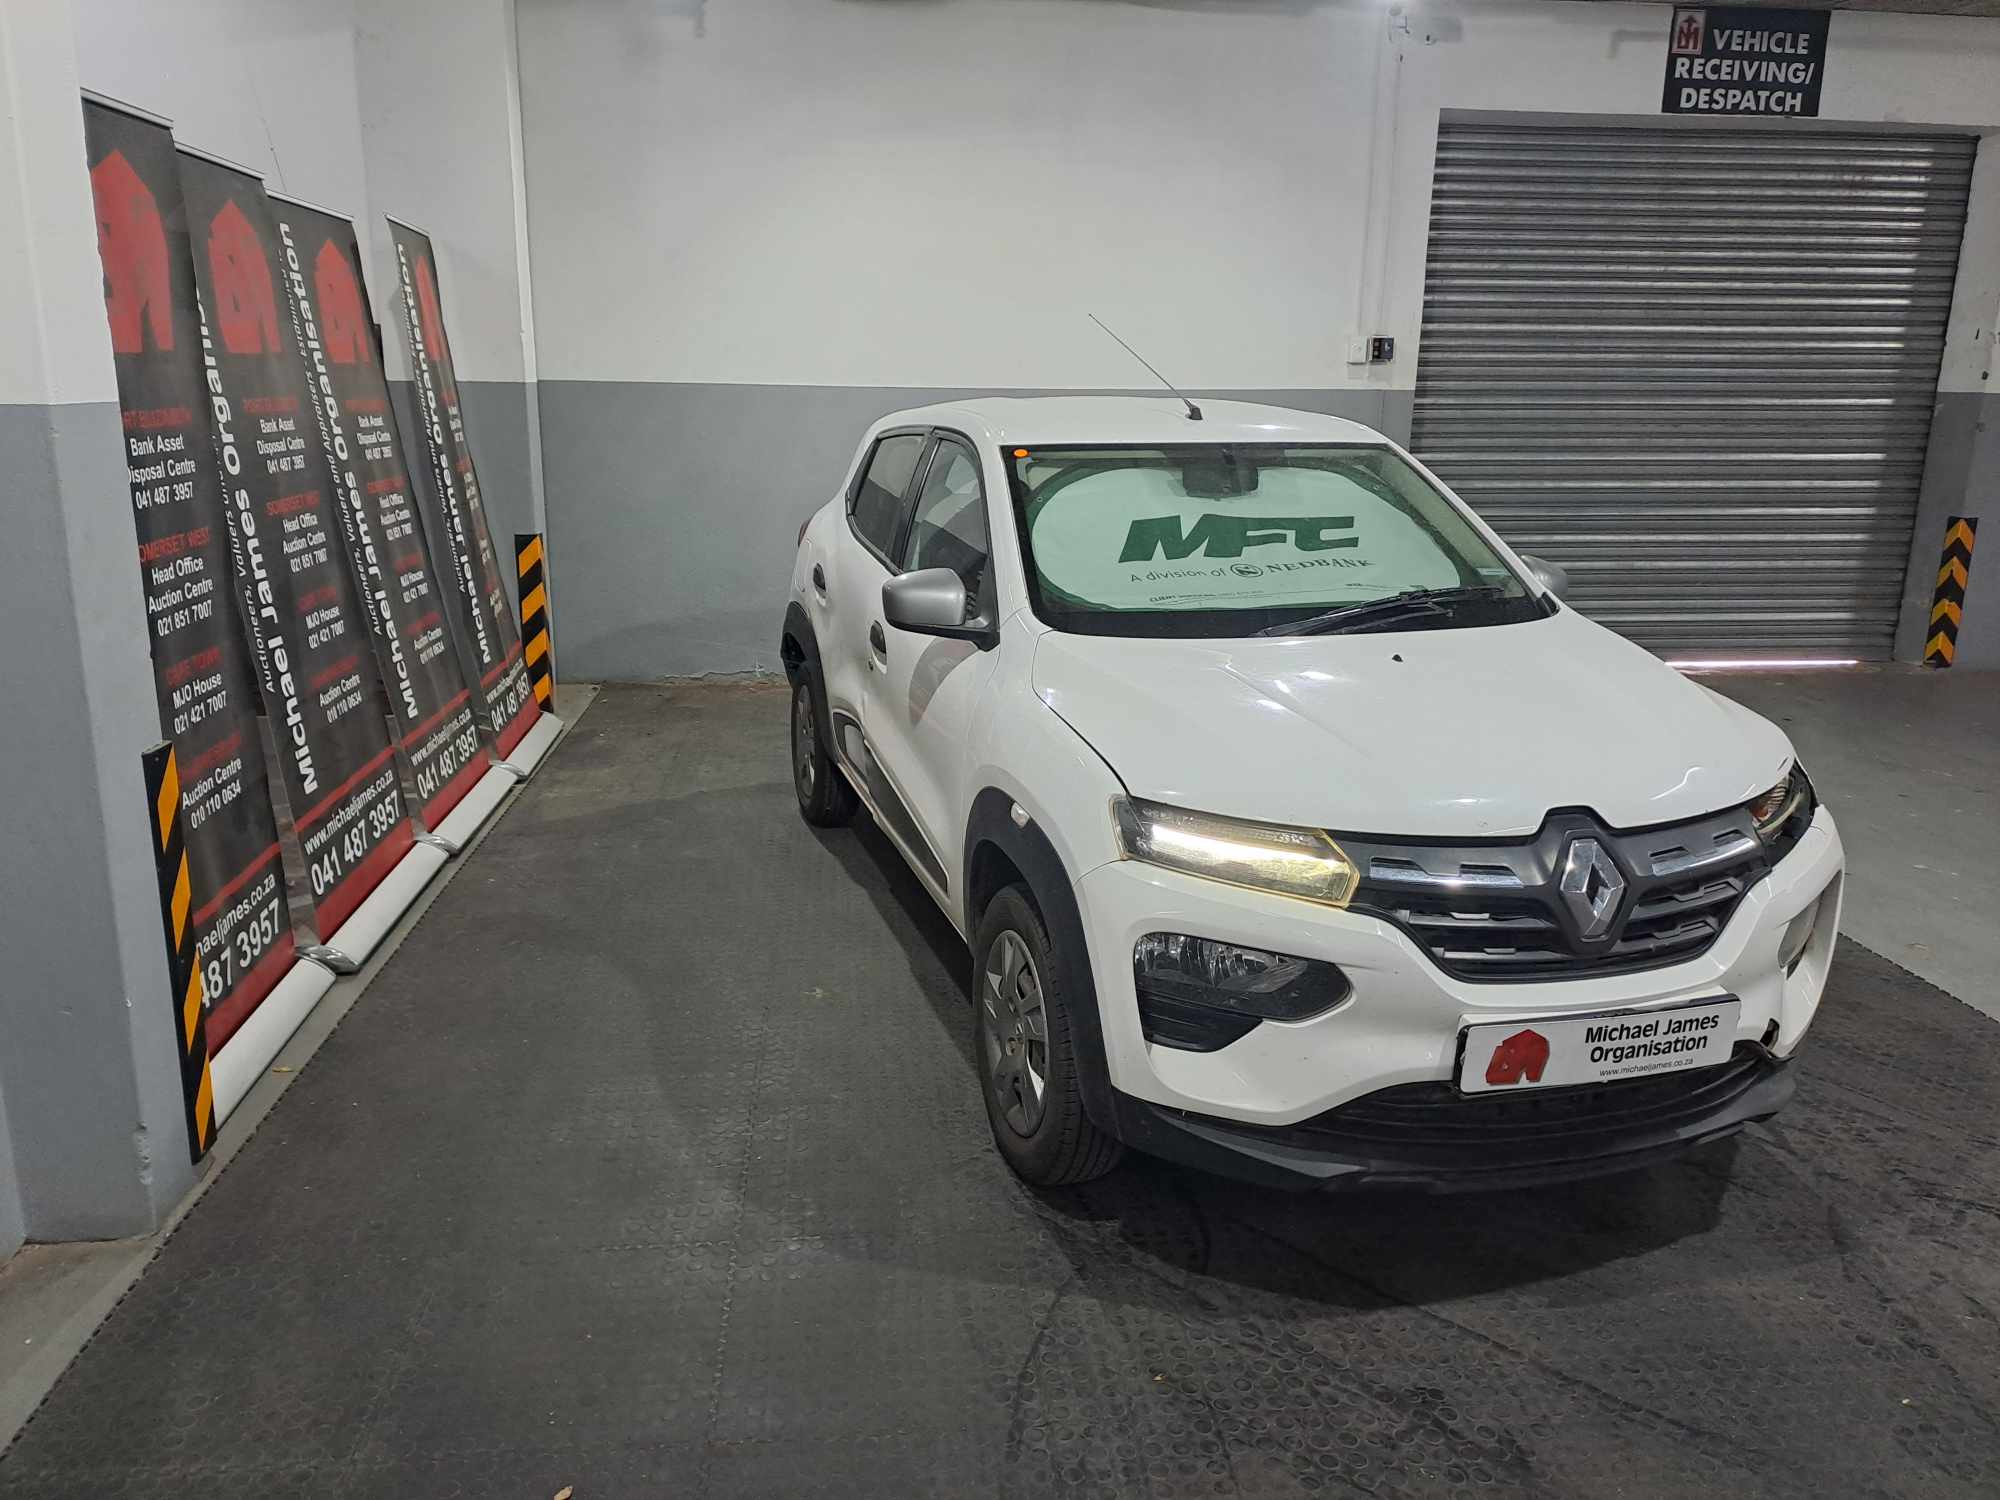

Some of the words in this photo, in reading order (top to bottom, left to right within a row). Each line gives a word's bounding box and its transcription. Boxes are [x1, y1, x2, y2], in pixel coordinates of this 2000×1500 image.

[1713, 29, 1810, 55] VEHICLE
[1675, 57, 1815, 85] RECEIVING/
[1679, 87, 1802, 113] DESPATCH
[279, 222, 349, 461] Organisation
[397, 243, 443, 445] Organisation
[130, 435, 155, 456] Bank
[157, 433, 185, 452] Asset
[266, 459, 279, 474] 041
[167, 458, 197, 477] Centre
[325, 454, 341, 484] and
[135, 489, 152, 509] 041
[154, 486, 170, 504] 487
[174, 481, 193, 501] 3957
[336, 488, 356, 542] Valuers
[440, 454, 466, 547] James
[225, 510, 247, 577] Valuers
[344, 471, 382, 582] James
[1118, 513, 1359, 563] MFC
[151, 563, 175, 586] Head
[176, 556, 204, 577] Office
[235, 489, 279, 623] James
[1131, 573, 1143, 582] A
[1146, 567, 1208, 582] division
[1210, 567, 1227, 577] of
[1266, 557, 1376, 574] NEDBANK
[148, 589, 184, 614] Auction
[184, 577, 214, 598] Centre
[319, 605, 340, 622] House
[459, 554, 491, 664] Michael
[157, 618, 173, 637] 021
[174, 609, 190, 630] 851
[192, 600, 213, 622] 7007
[374, 590, 419, 719] Michael
[172, 689, 192, 710] MJO
[192, 673, 222, 697] House
[174, 715, 189, 735] 021
[190, 703, 206, 724] 421
[206, 691, 228, 715] 7007
[268, 635, 318, 795] Michael
[182, 776, 214, 810] Auction
[214, 756, 242, 785] Centre
[417, 761, 440, 800] 041
[440, 743, 458, 779] 487
[456, 724, 478, 762] 3957
[190, 808, 206, 829] 010
[206, 795, 221, 817] 110
[221, 779, 242, 805] 0634
[311, 846, 342, 896] 041
[343, 818, 369, 864] 487
[369, 788, 400, 840] 3957
[236, 896, 280, 969] 3957
[1584, 1019, 1661, 1044] Michael
[1663, 1014, 1720, 1036] James
[1589, 1035, 1709, 1063] Organisation
